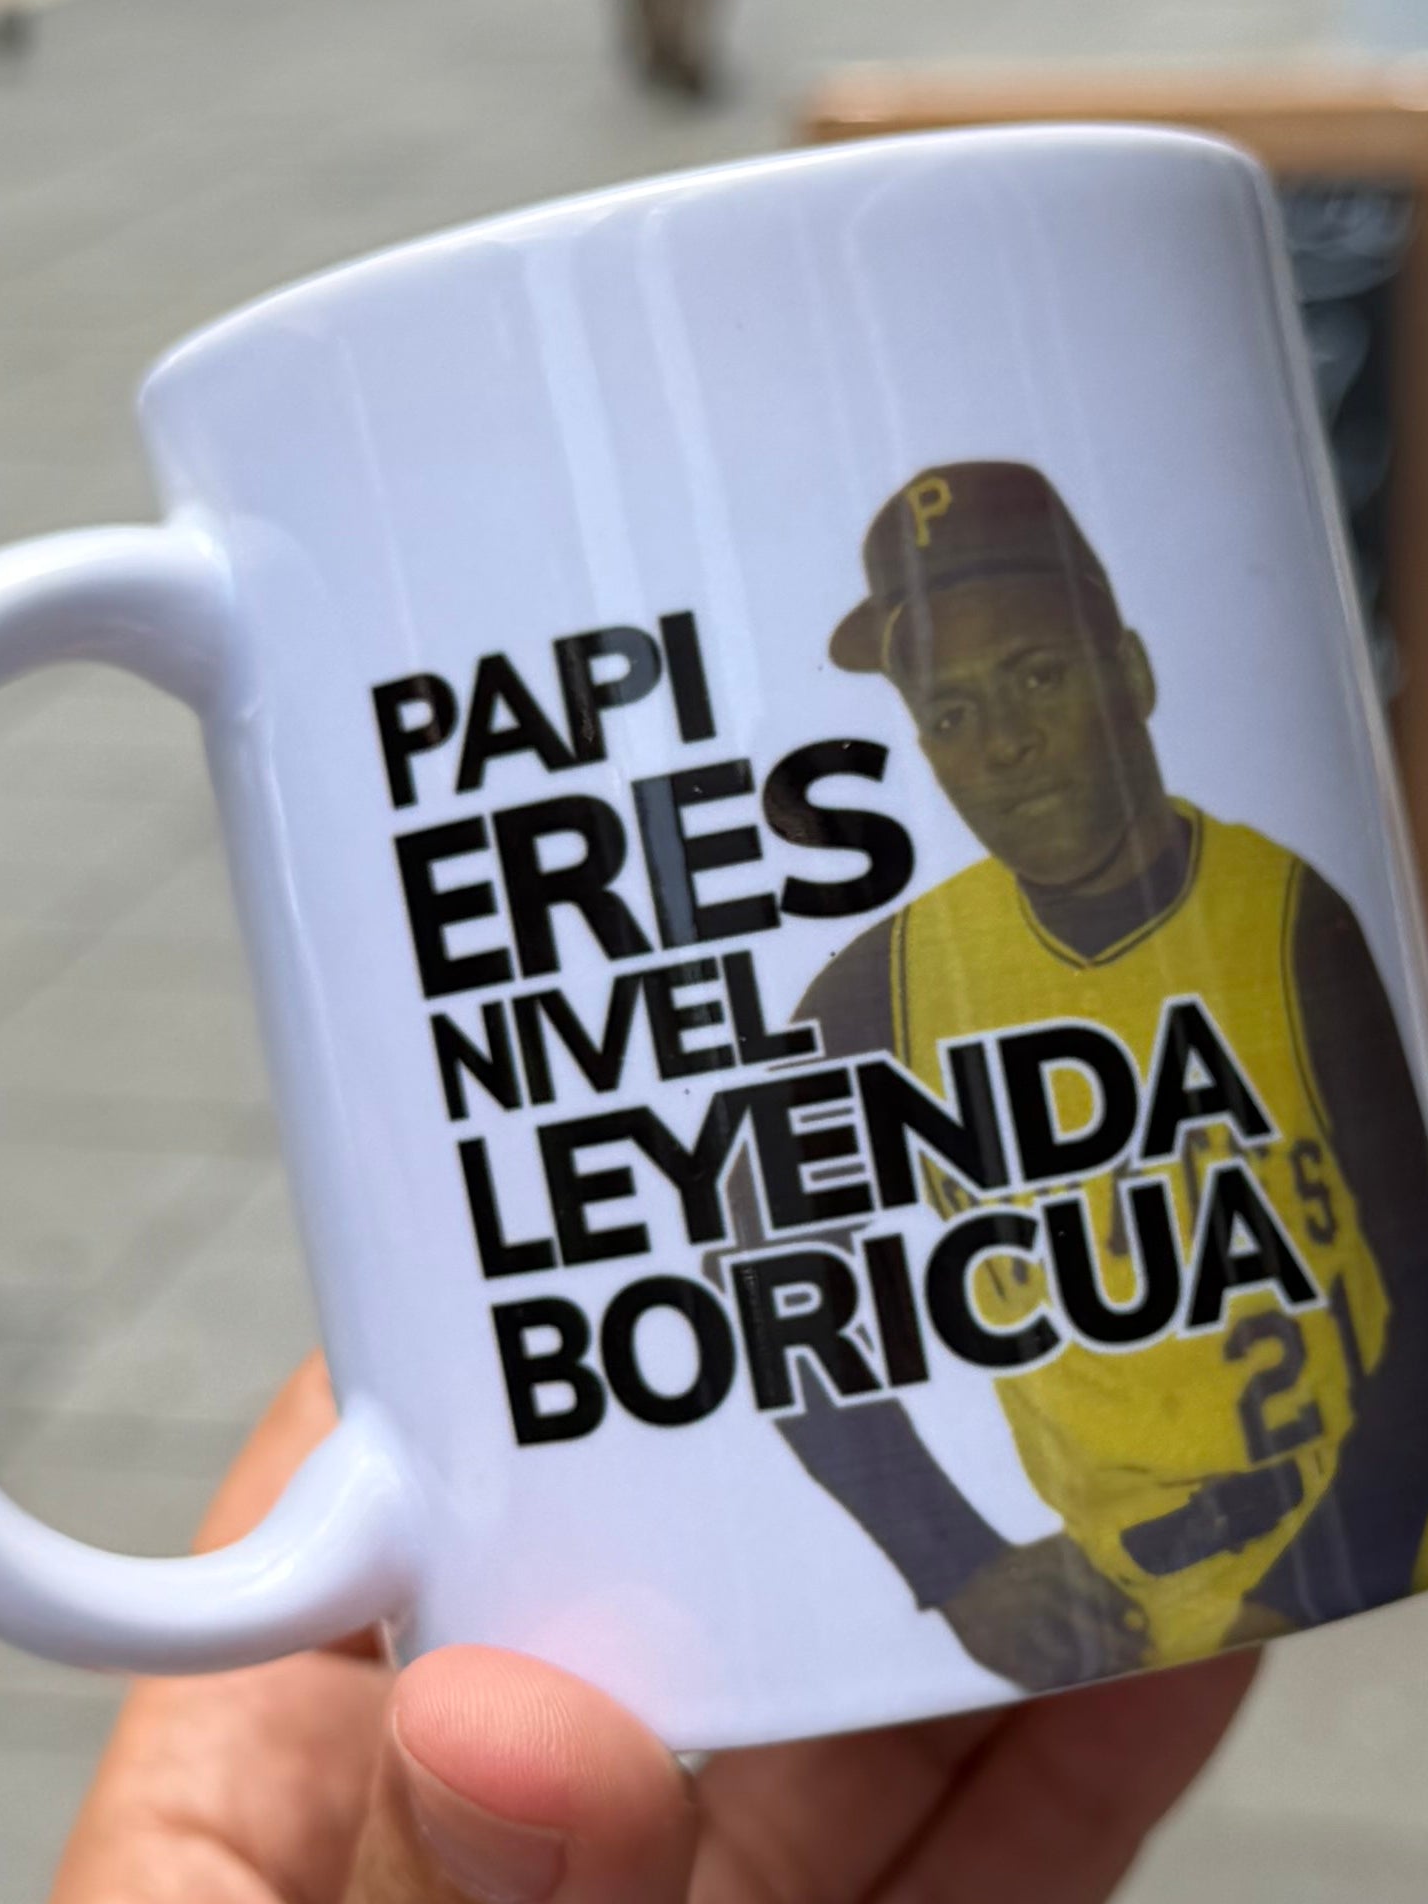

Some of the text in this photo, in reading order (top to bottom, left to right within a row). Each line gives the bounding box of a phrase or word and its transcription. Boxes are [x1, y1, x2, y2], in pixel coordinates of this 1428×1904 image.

[907, 476, 952, 548] P
[372, 611, 716, 807] PAPI
[394, 739, 916, 998] ERES
[431, 951, 817, 1121] NIVEL
[456, 1002, 1273, 1280] LEYENDA
[491, 1166, 1318, 1447] BORICUA
